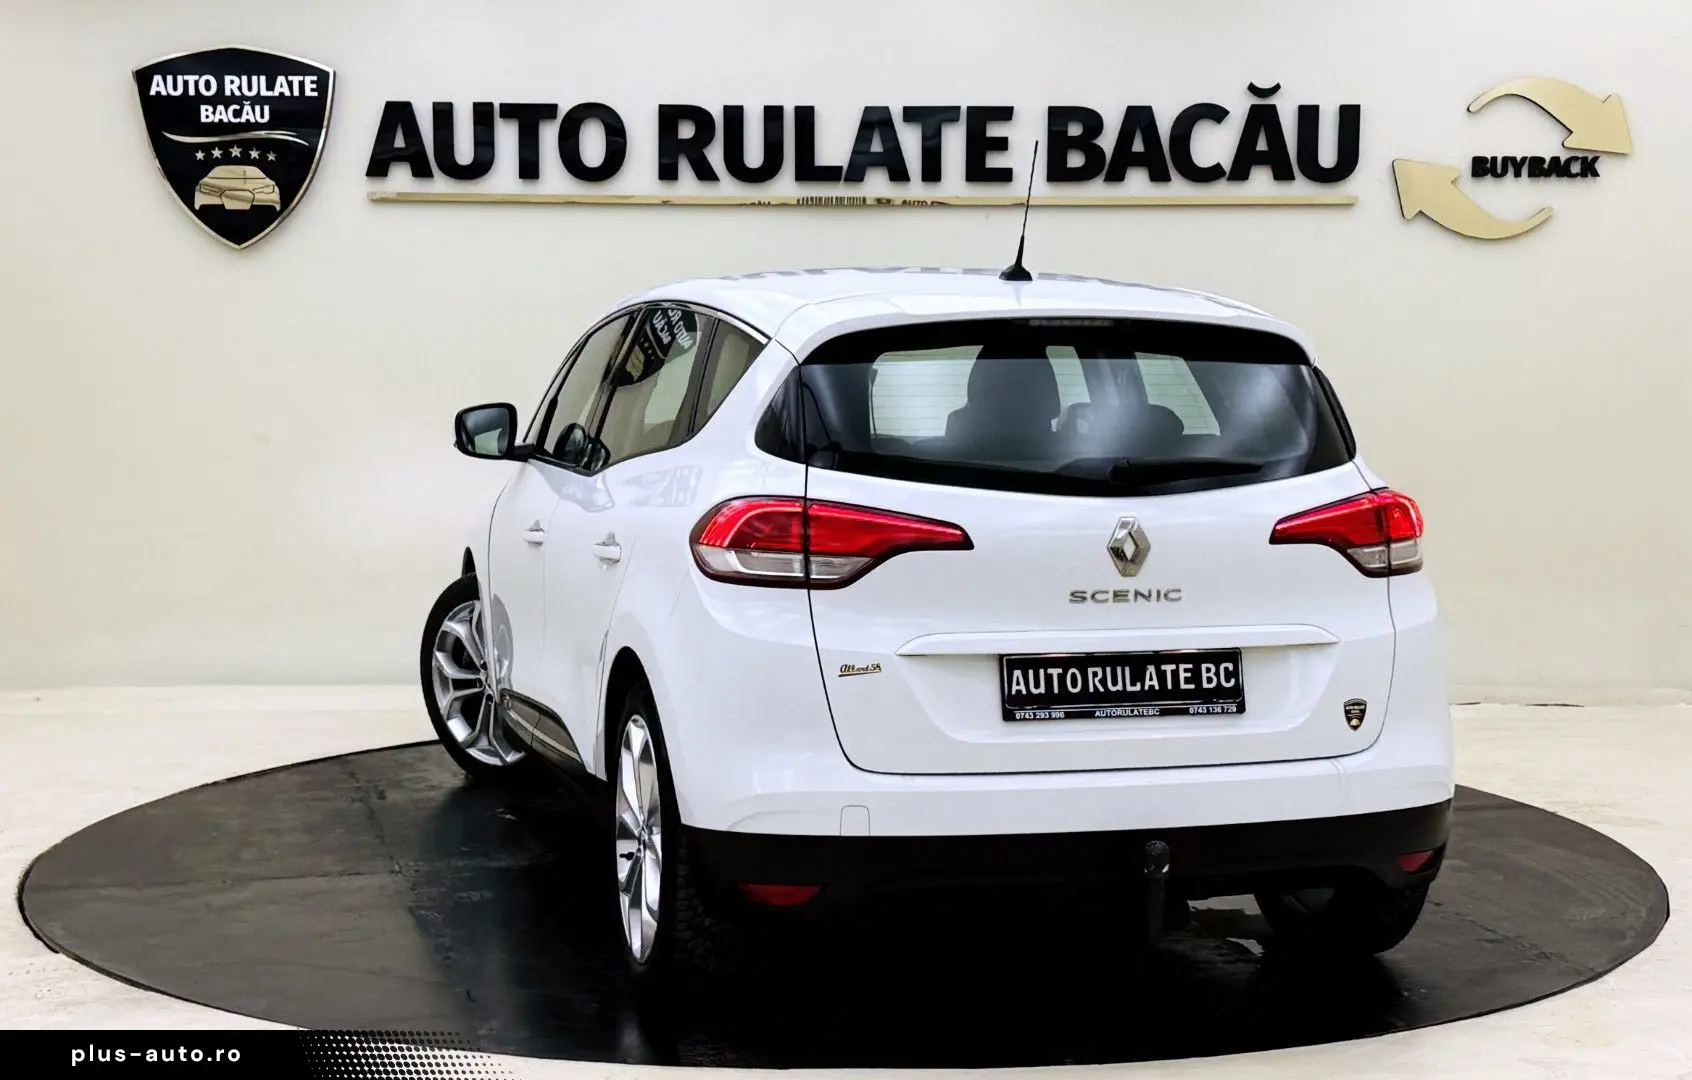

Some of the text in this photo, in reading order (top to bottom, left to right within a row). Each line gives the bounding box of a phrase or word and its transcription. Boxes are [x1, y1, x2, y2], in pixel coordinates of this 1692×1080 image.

[149, 74, 319, 97] AUTO RULATE
[199, 100, 270, 123] BACĂU
[365, 81, 1362, 184] AUTO RULATE BACĂU
[1471, 155, 1601, 179] BUYBACK
[1068, 588, 1182, 604] SCENIC
[1011, 662, 1236, 695] AUTO RULATE BC
[1094, 708, 1160, 717] AUTORULATEBC
